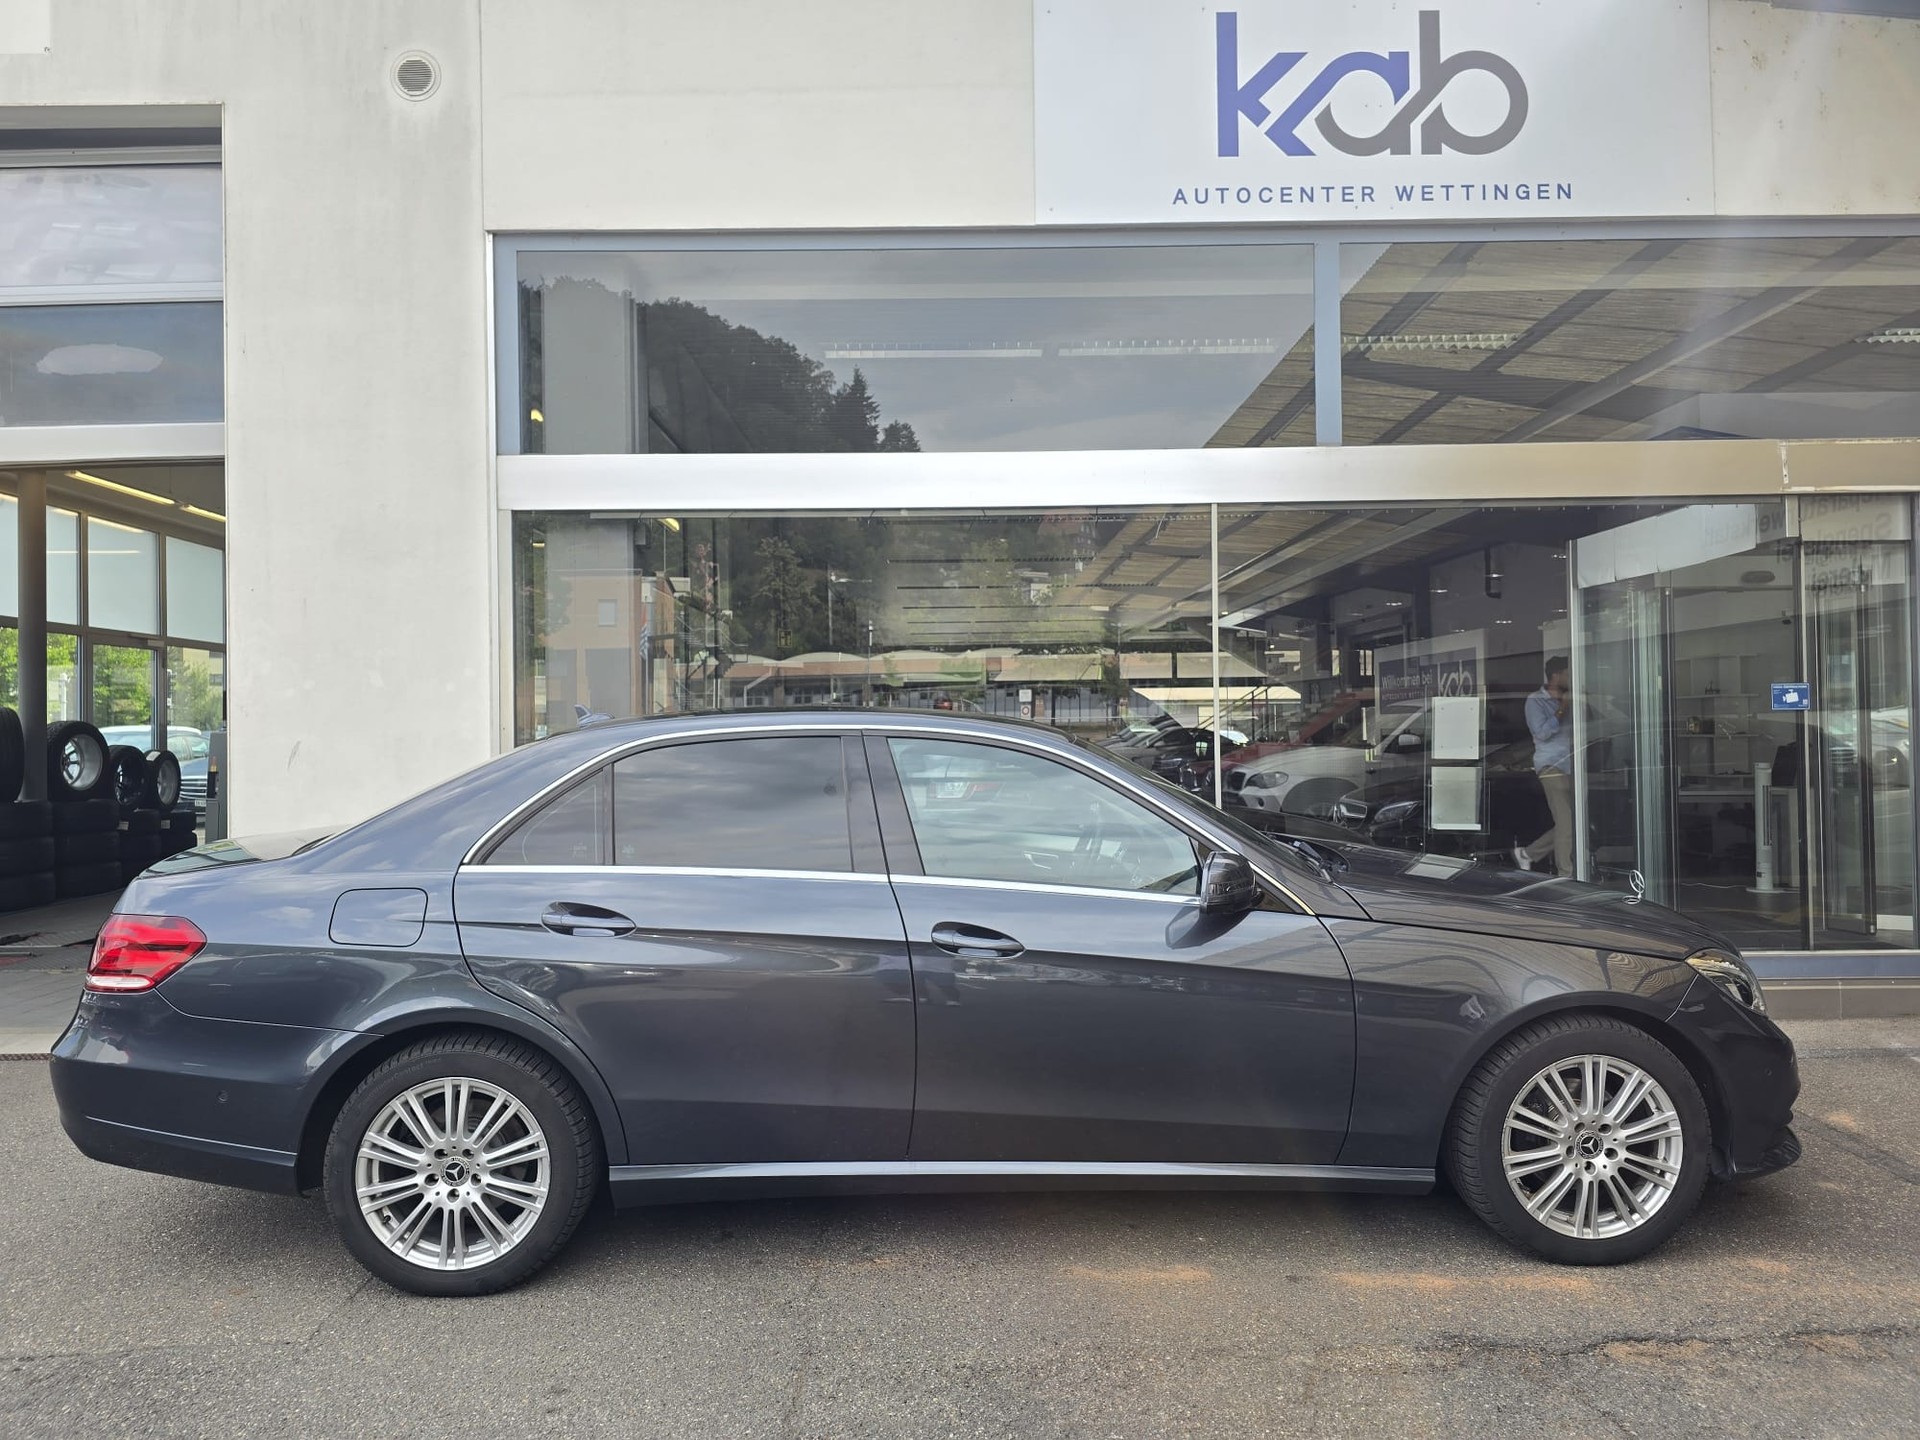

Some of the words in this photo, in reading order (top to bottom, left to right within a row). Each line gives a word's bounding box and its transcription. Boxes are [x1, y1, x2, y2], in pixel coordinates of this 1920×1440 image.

[1216, 10, 1529, 157] kab
[1172, 185, 1375, 206] AUTOCENTER
[1394, 182, 1572, 203] WETTINGEN
